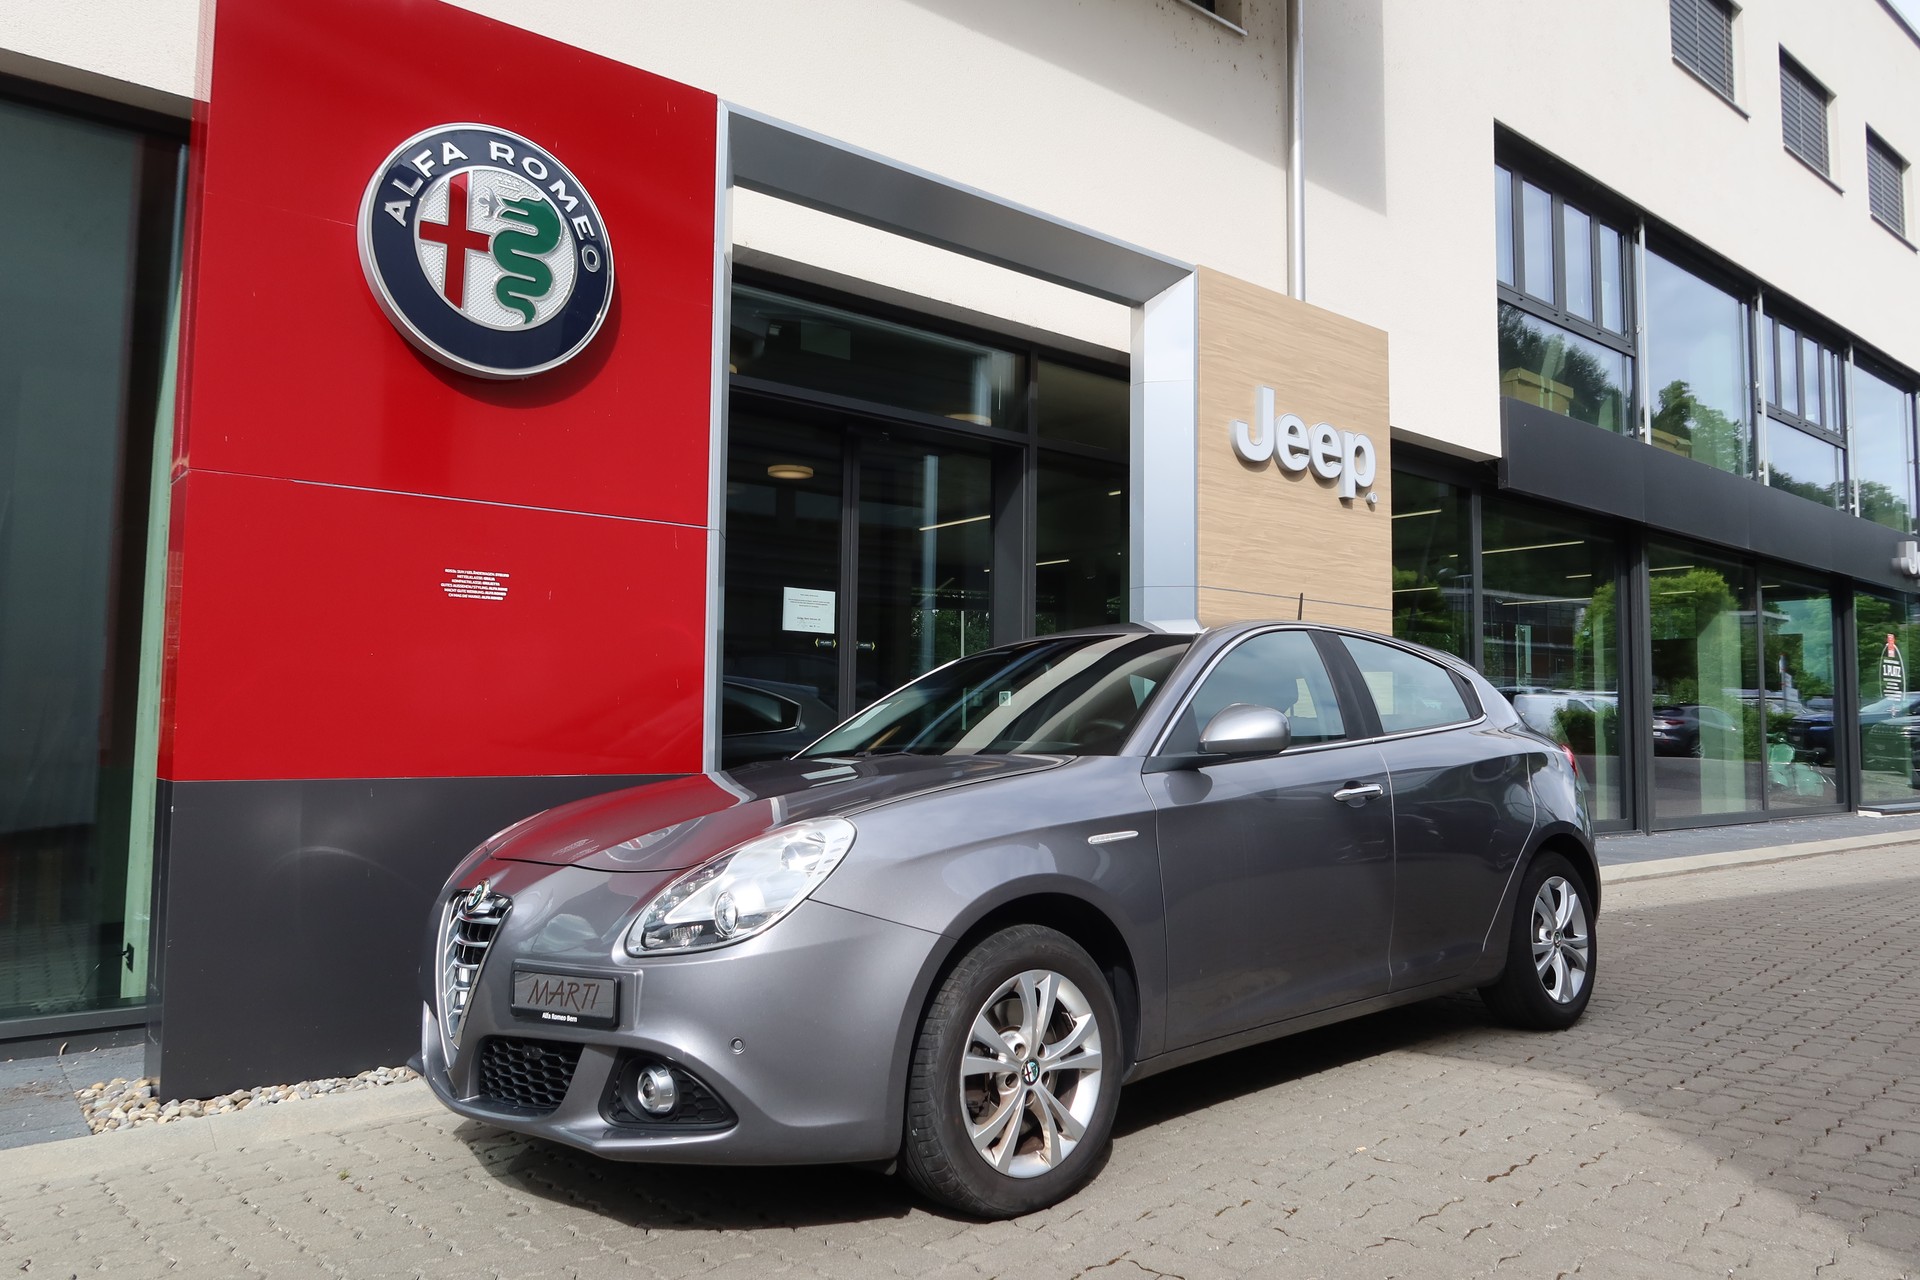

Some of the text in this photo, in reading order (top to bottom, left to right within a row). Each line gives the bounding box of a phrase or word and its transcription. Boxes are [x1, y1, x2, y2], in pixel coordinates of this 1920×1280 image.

[384, 140, 600, 273] ALFA ROMEO
[1229, 384, 1376, 500] Jeep
[527, 978, 600, 1012] MARTI
[551, 1013, 566, 1021] Romeo
